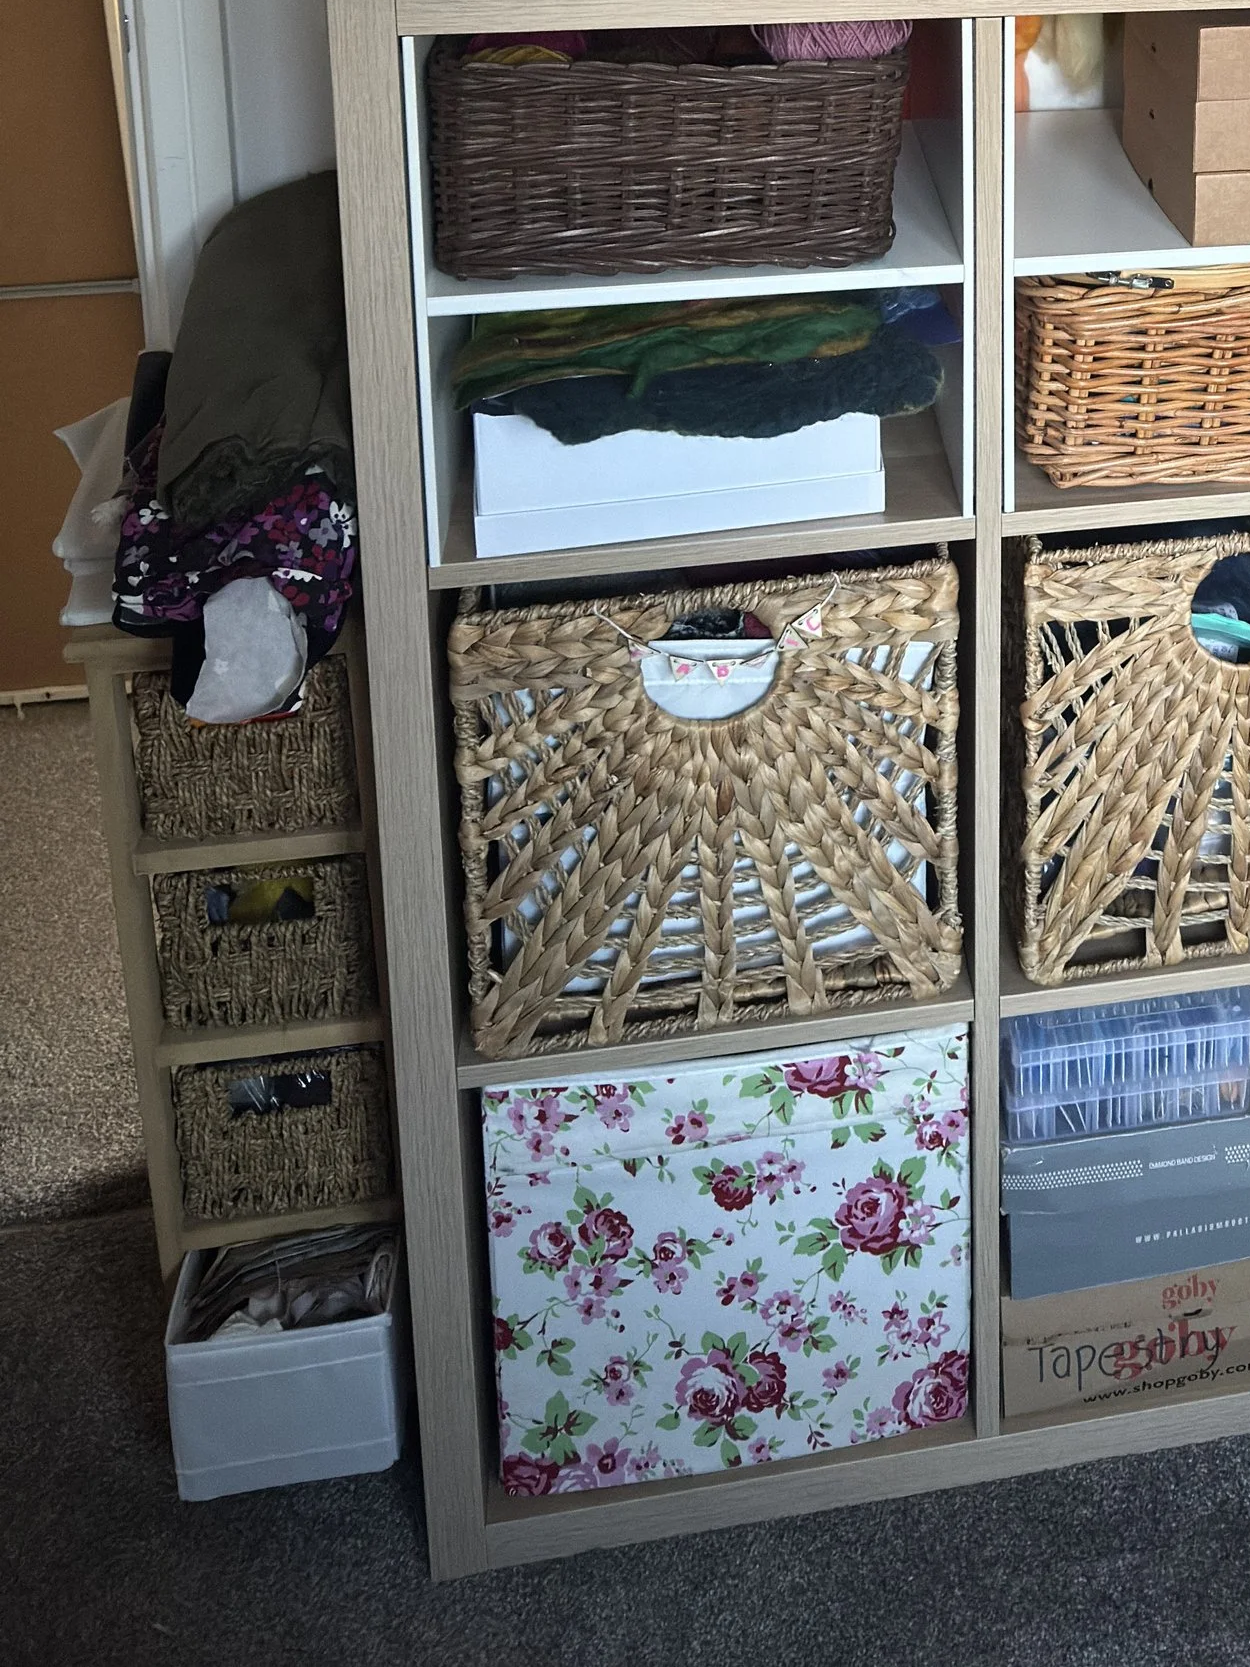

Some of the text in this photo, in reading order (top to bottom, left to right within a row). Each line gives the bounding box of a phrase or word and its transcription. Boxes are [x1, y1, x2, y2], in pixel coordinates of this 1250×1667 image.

[1149, 1153, 1216, 1170] DIAMOND BAND DESIGN
[1161, 1273, 1219, 1310] goby
[1027, 1327, 1222, 1392] Tapestry
[1112, 1319, 1238, 1381] goby
